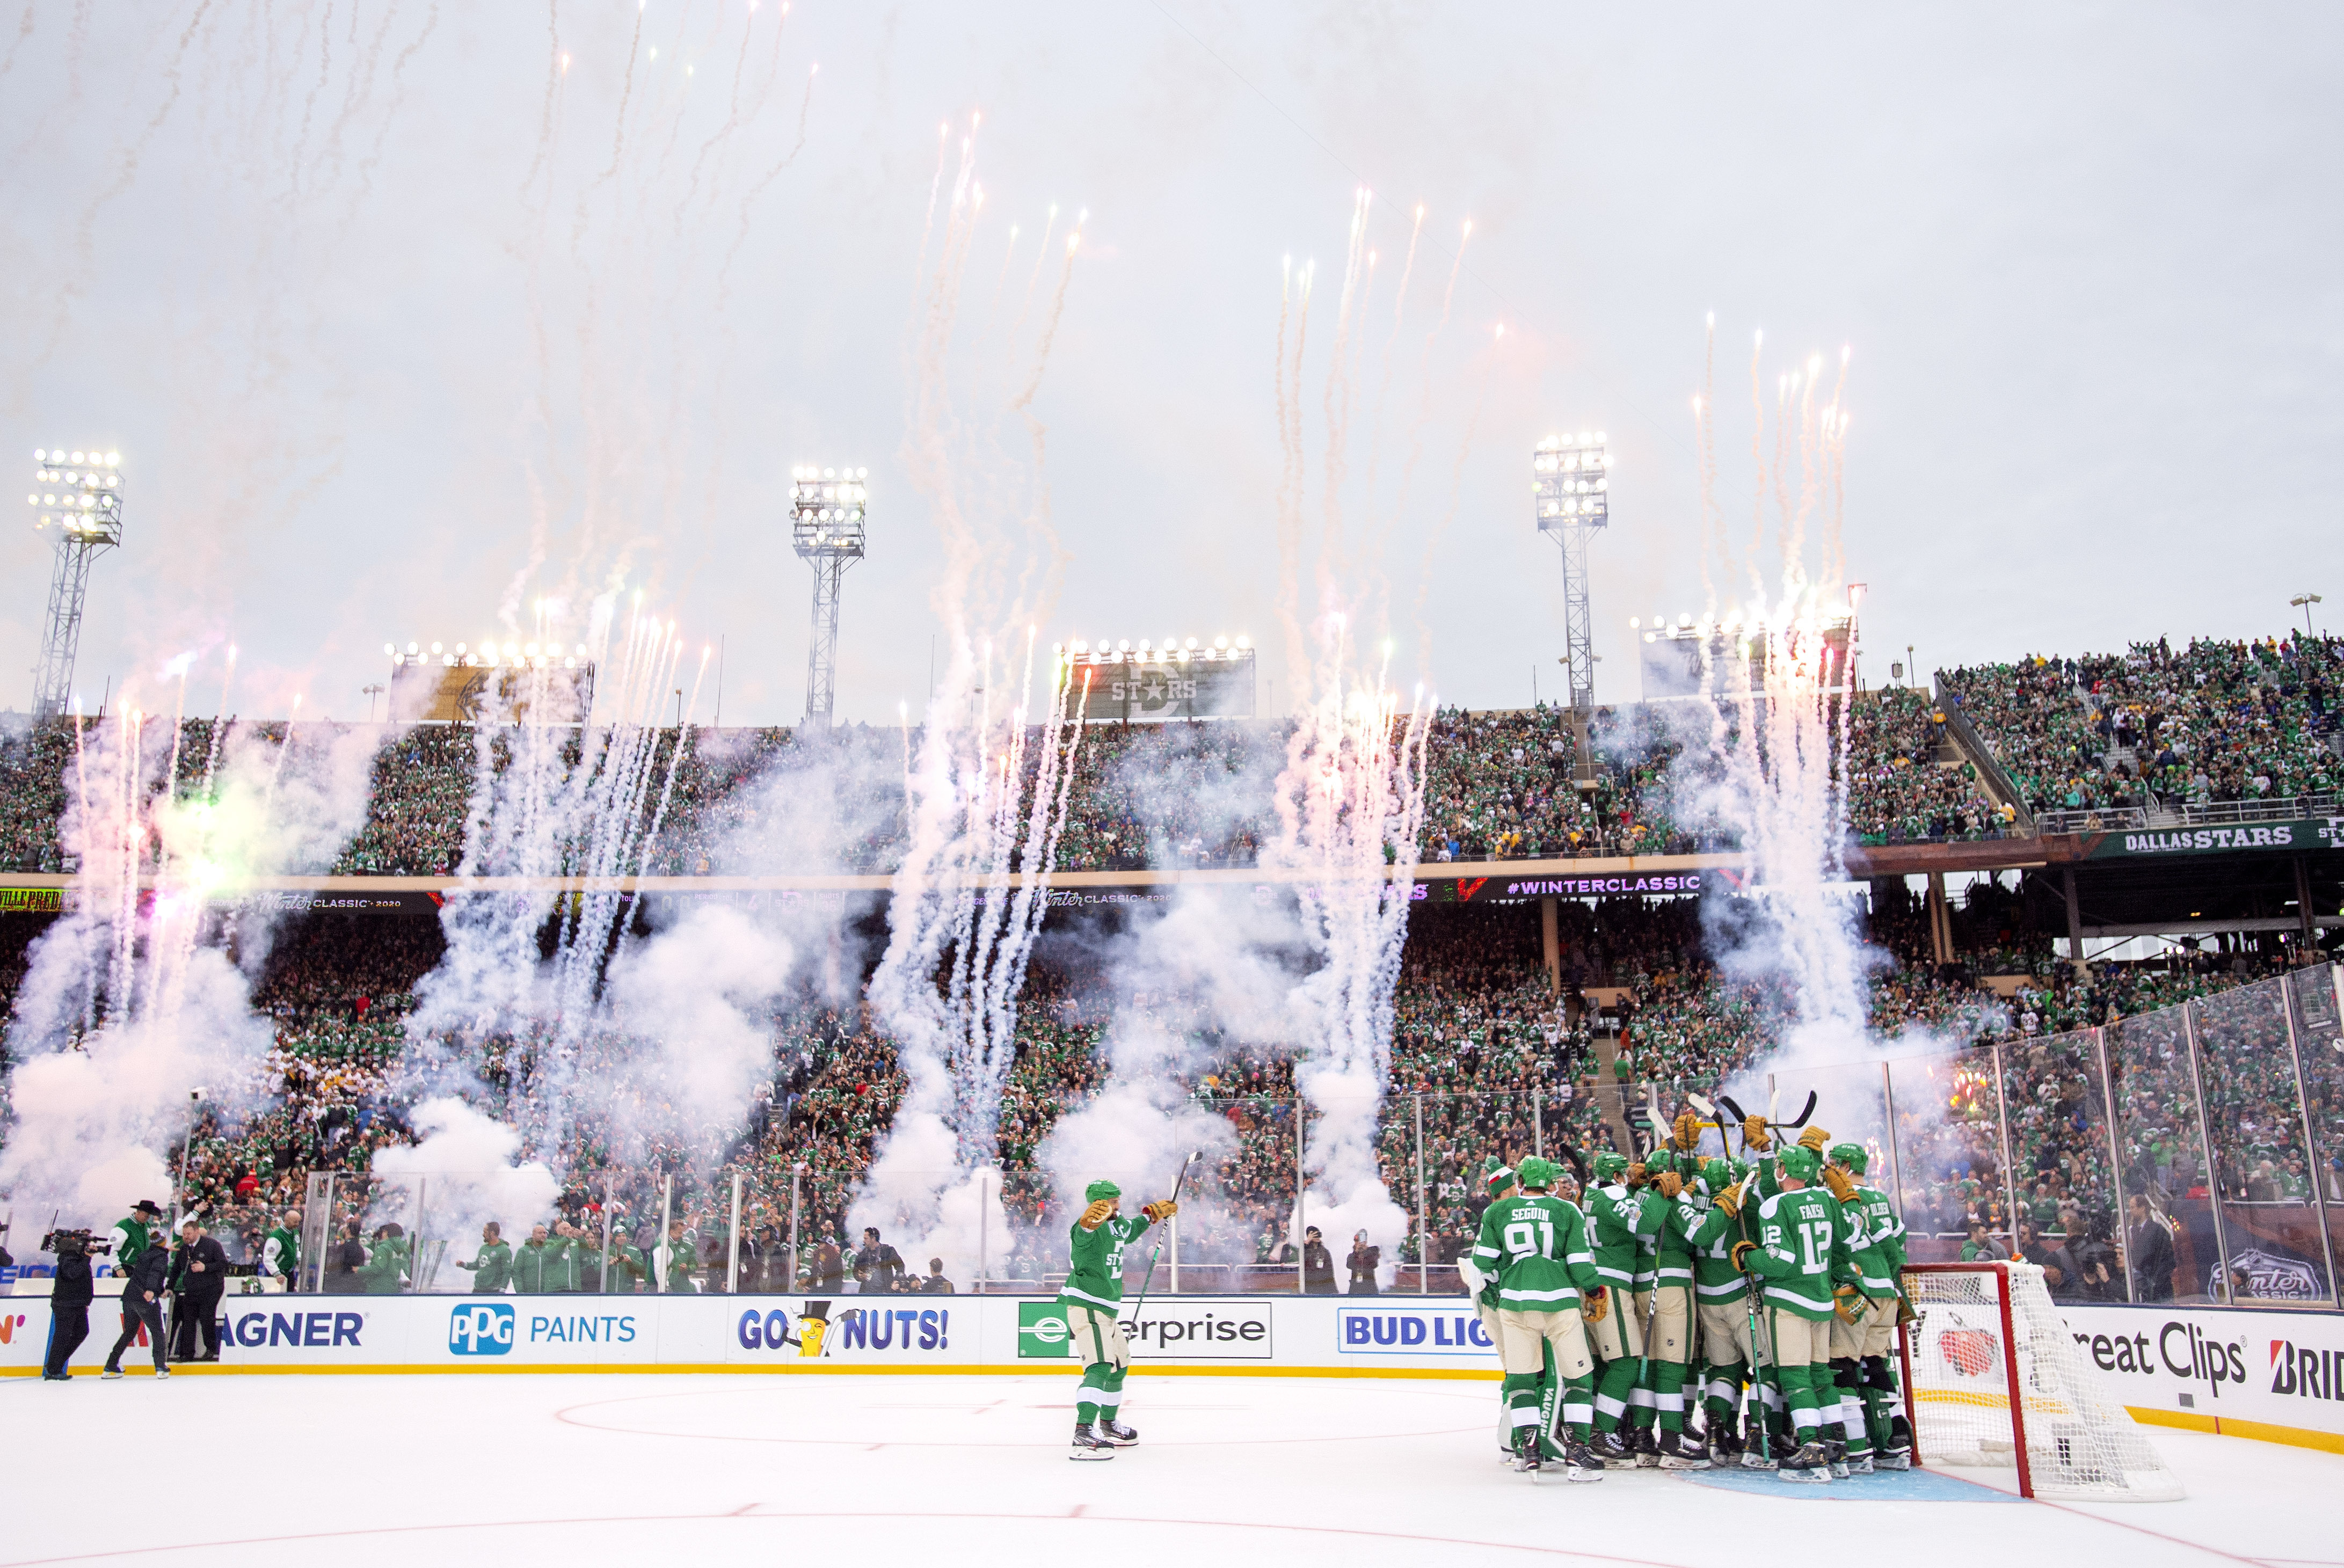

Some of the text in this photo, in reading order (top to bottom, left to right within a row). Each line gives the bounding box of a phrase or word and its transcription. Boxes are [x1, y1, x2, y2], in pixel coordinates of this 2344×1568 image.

[1083, 895, 1138, 903] CLASSIC
[1508, 876, 1700, 894] #WINTERCLASSIC
[312, 899, 368, 908] CLASSIC
[1511, 1207, 1550, 1222] SEGUIN
[1799, 1204, 1825, 1220] FAKSA
[1504, 1222, 1559, 1265] 91
[1762, 1225, 1782, 1245] 12
[1799, 1221, 1832, 1274] 12
[451, 1307, 636, 1352] PPG PAINTS
[738, 1309, 949, 1350] GO NUTS!
[1346, 1316, 1495, 1347] BUD LIG
[2159, 1321, 2246, 1398] Clips
[1540, 1388, 1555, 1438] VAUGHN
